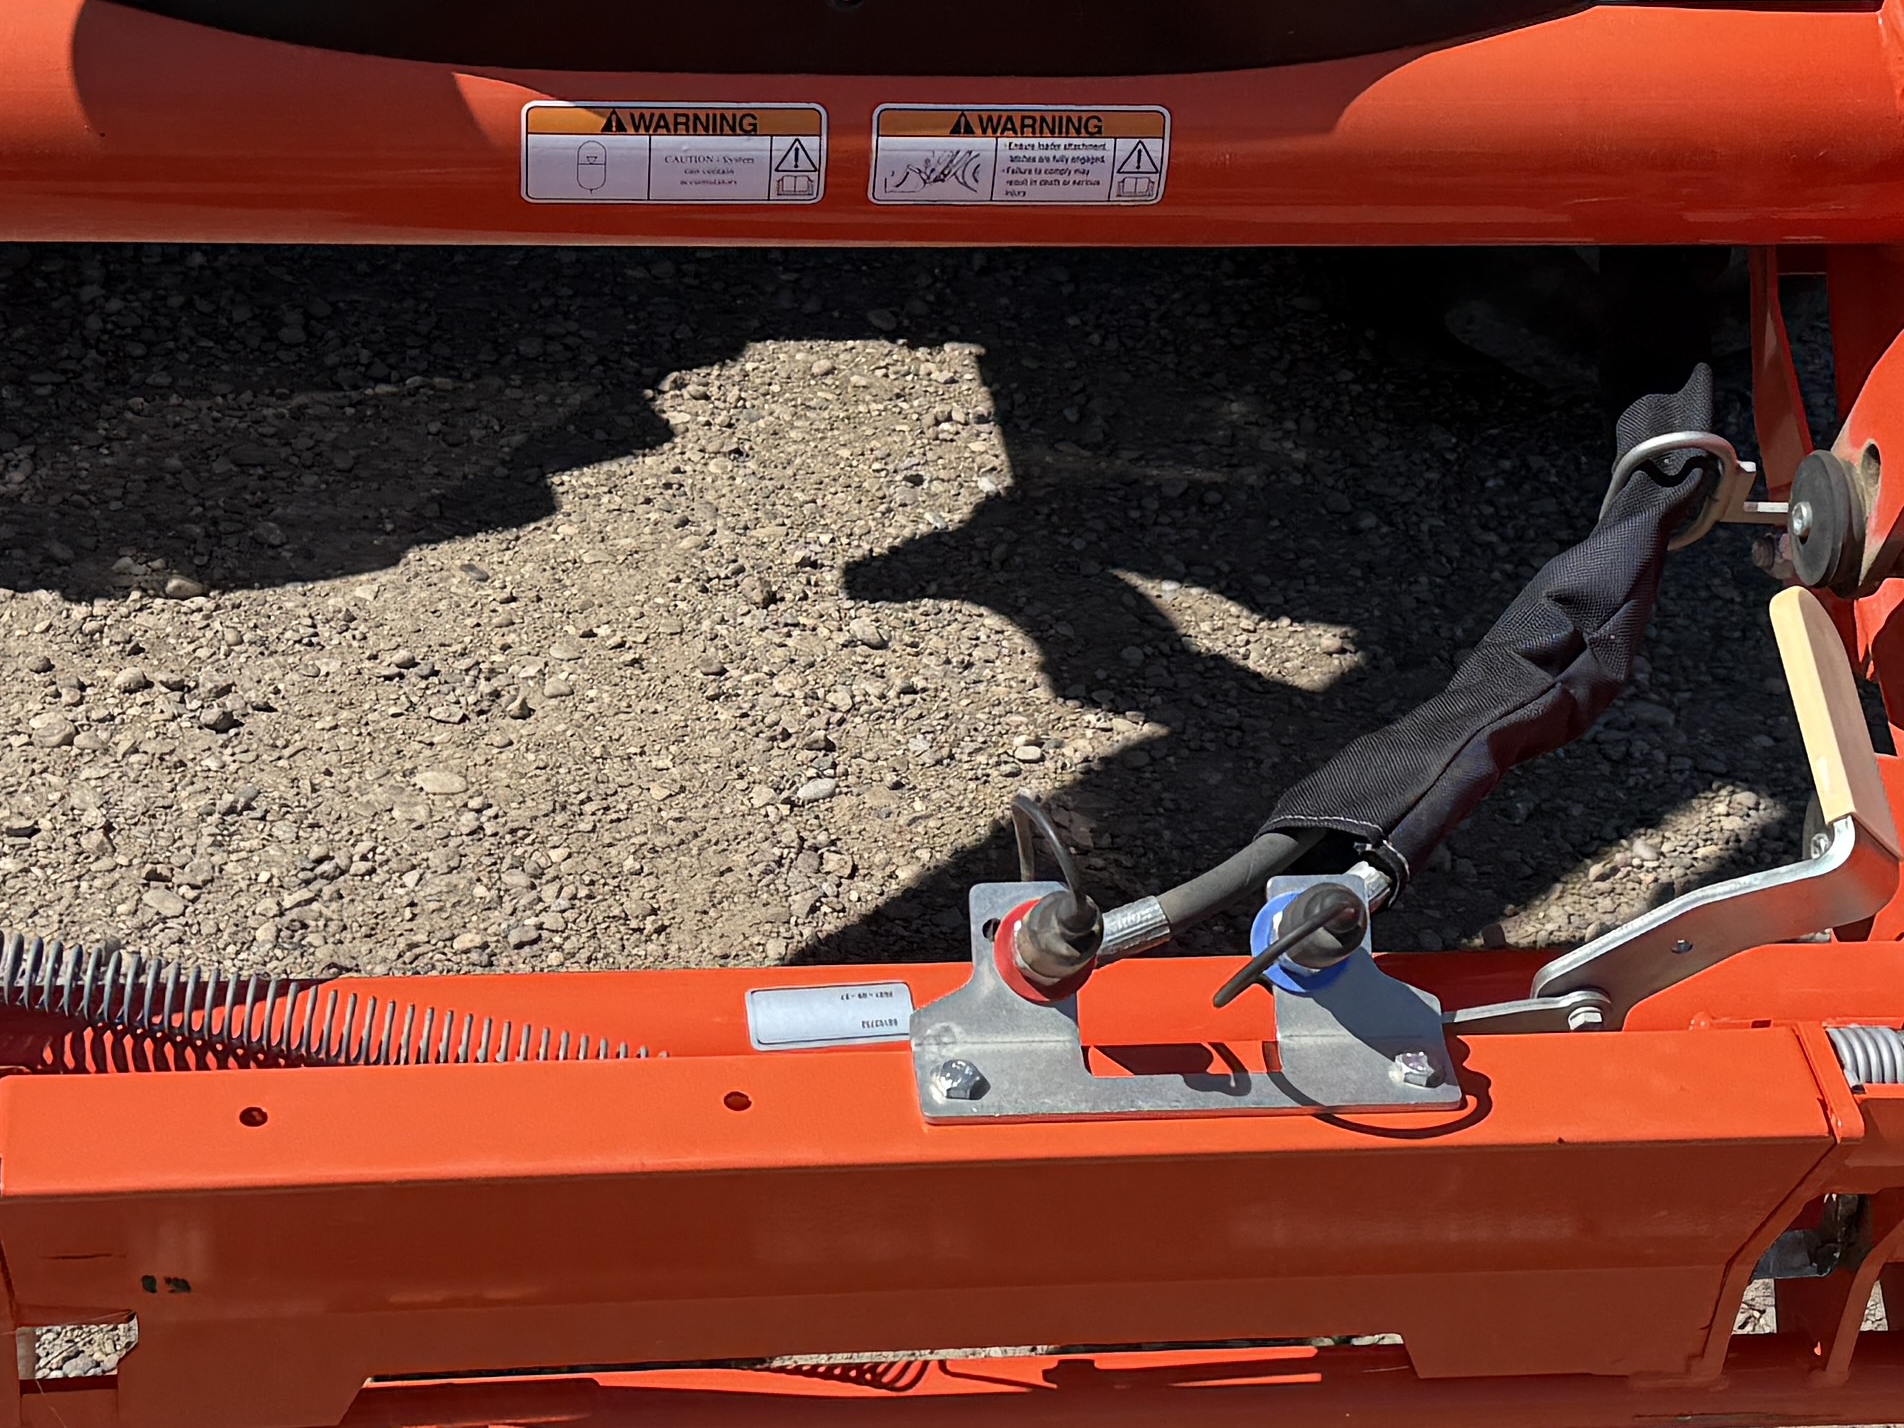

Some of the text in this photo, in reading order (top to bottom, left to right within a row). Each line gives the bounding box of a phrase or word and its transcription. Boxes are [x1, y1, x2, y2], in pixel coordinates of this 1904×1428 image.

[629, 113, 758, 134] WARNING
[978, 114, 1103, 136] WARNING
[664, 155, 714, 164] CAUTION
